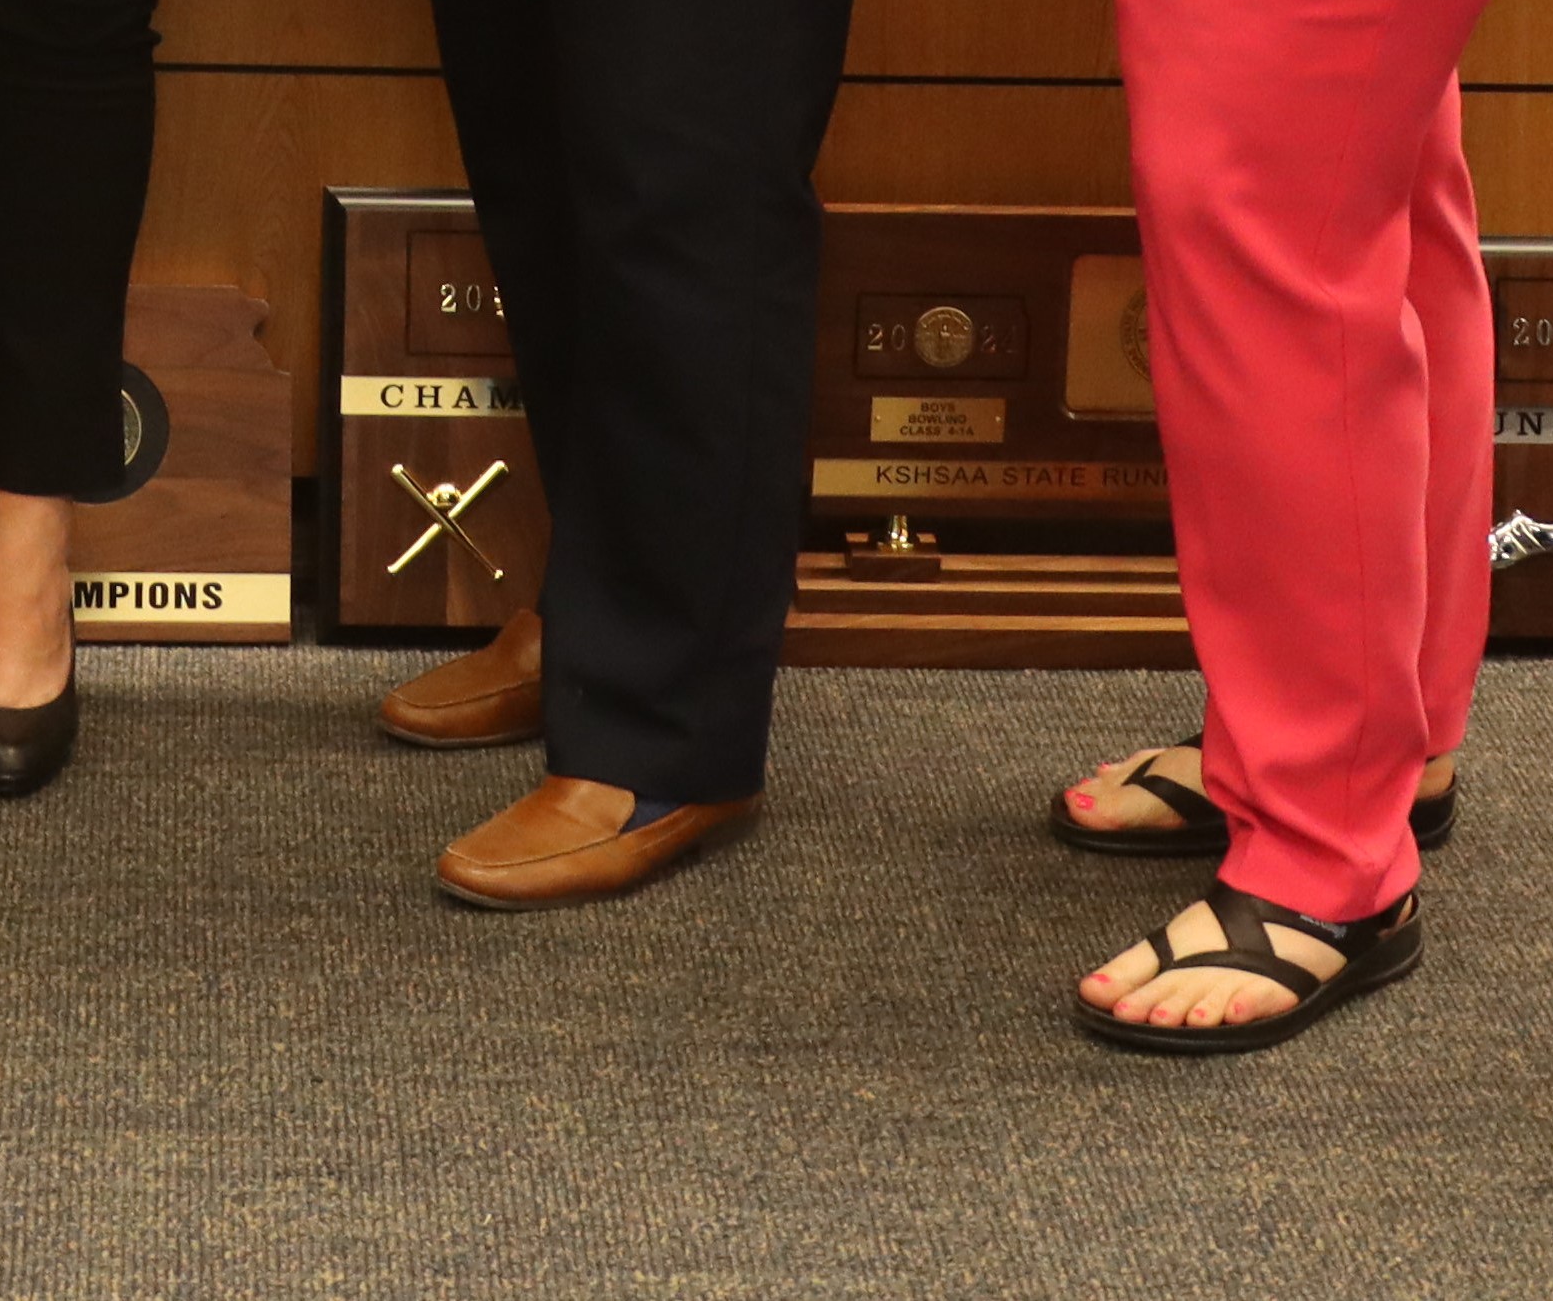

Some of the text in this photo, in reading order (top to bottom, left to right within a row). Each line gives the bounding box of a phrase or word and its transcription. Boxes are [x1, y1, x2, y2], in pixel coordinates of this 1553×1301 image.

[440, 283, 481, 312] 20
[920, 402, 956, 413] BOYS
[899, 425, 941, 437] CLASS
[875, 465, 1166, 487] KSHSAA STATE RUN
